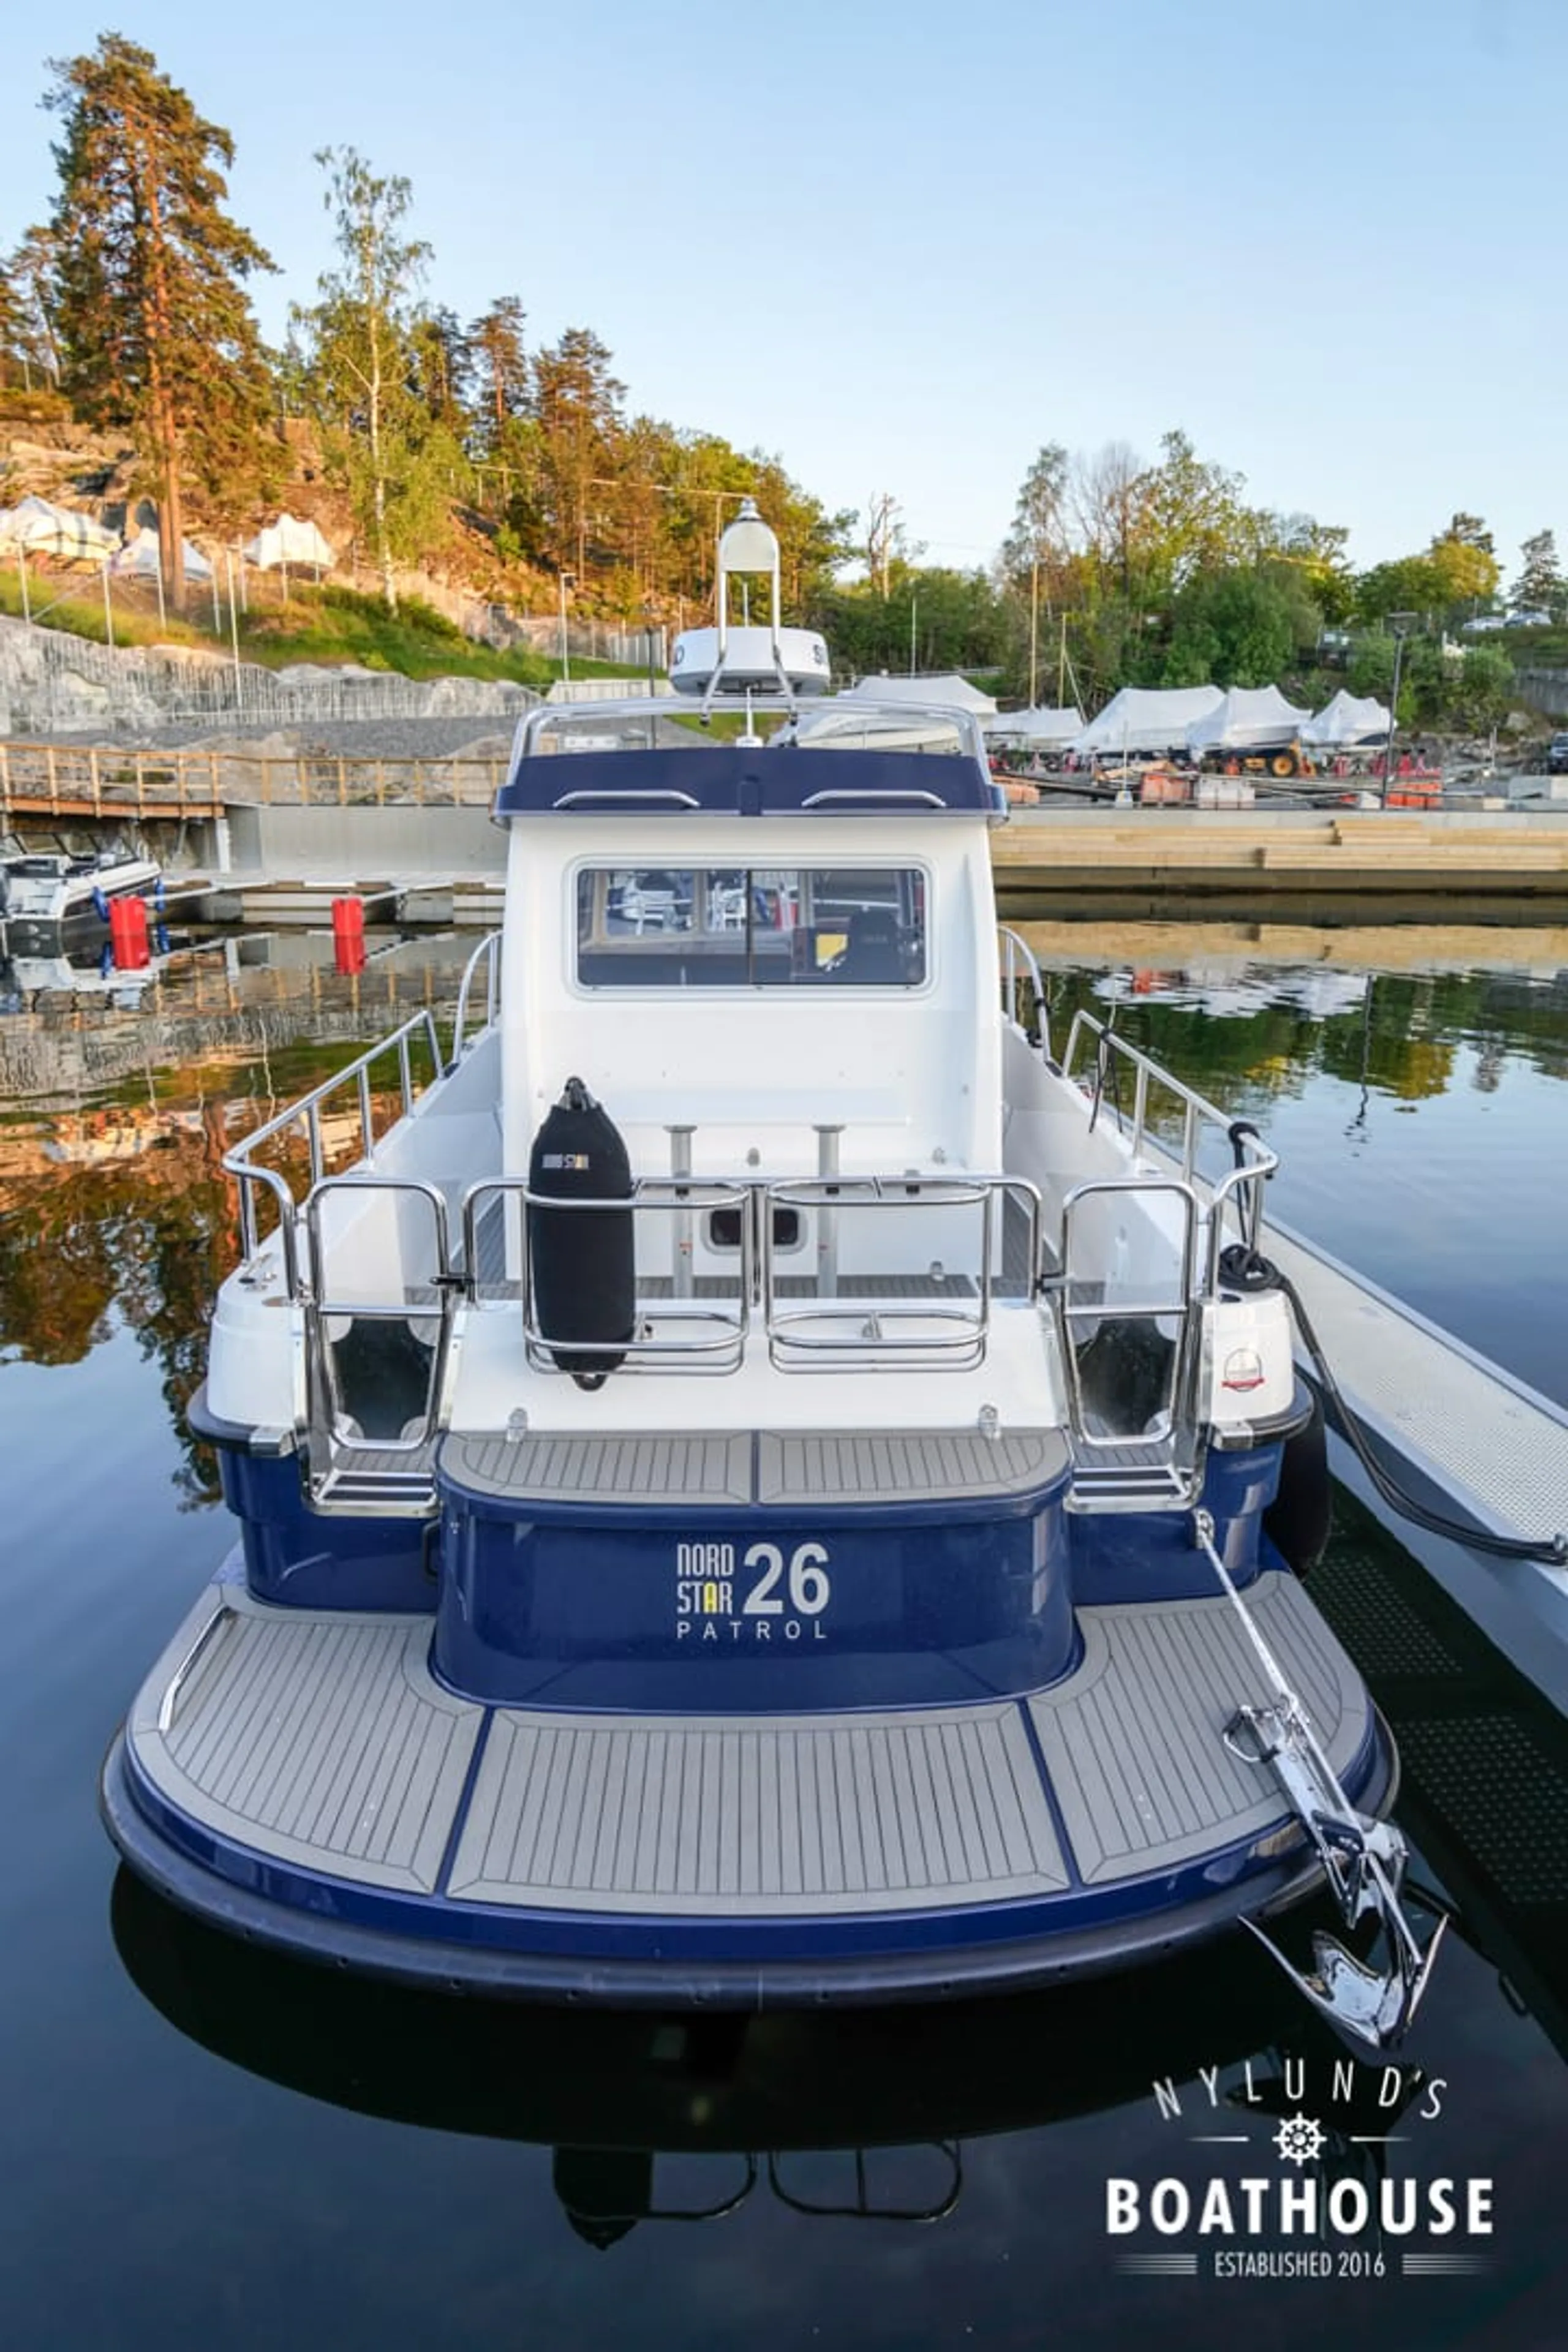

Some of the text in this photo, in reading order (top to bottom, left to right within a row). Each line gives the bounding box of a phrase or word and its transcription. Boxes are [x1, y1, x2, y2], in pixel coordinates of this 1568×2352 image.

[677, 1543, 734, 1577] NORD
[742, 1542, 830, 1615] 26
[677, 1580, 733, 1615] STAR
[677, 1619, 827, 1640] PATROL
